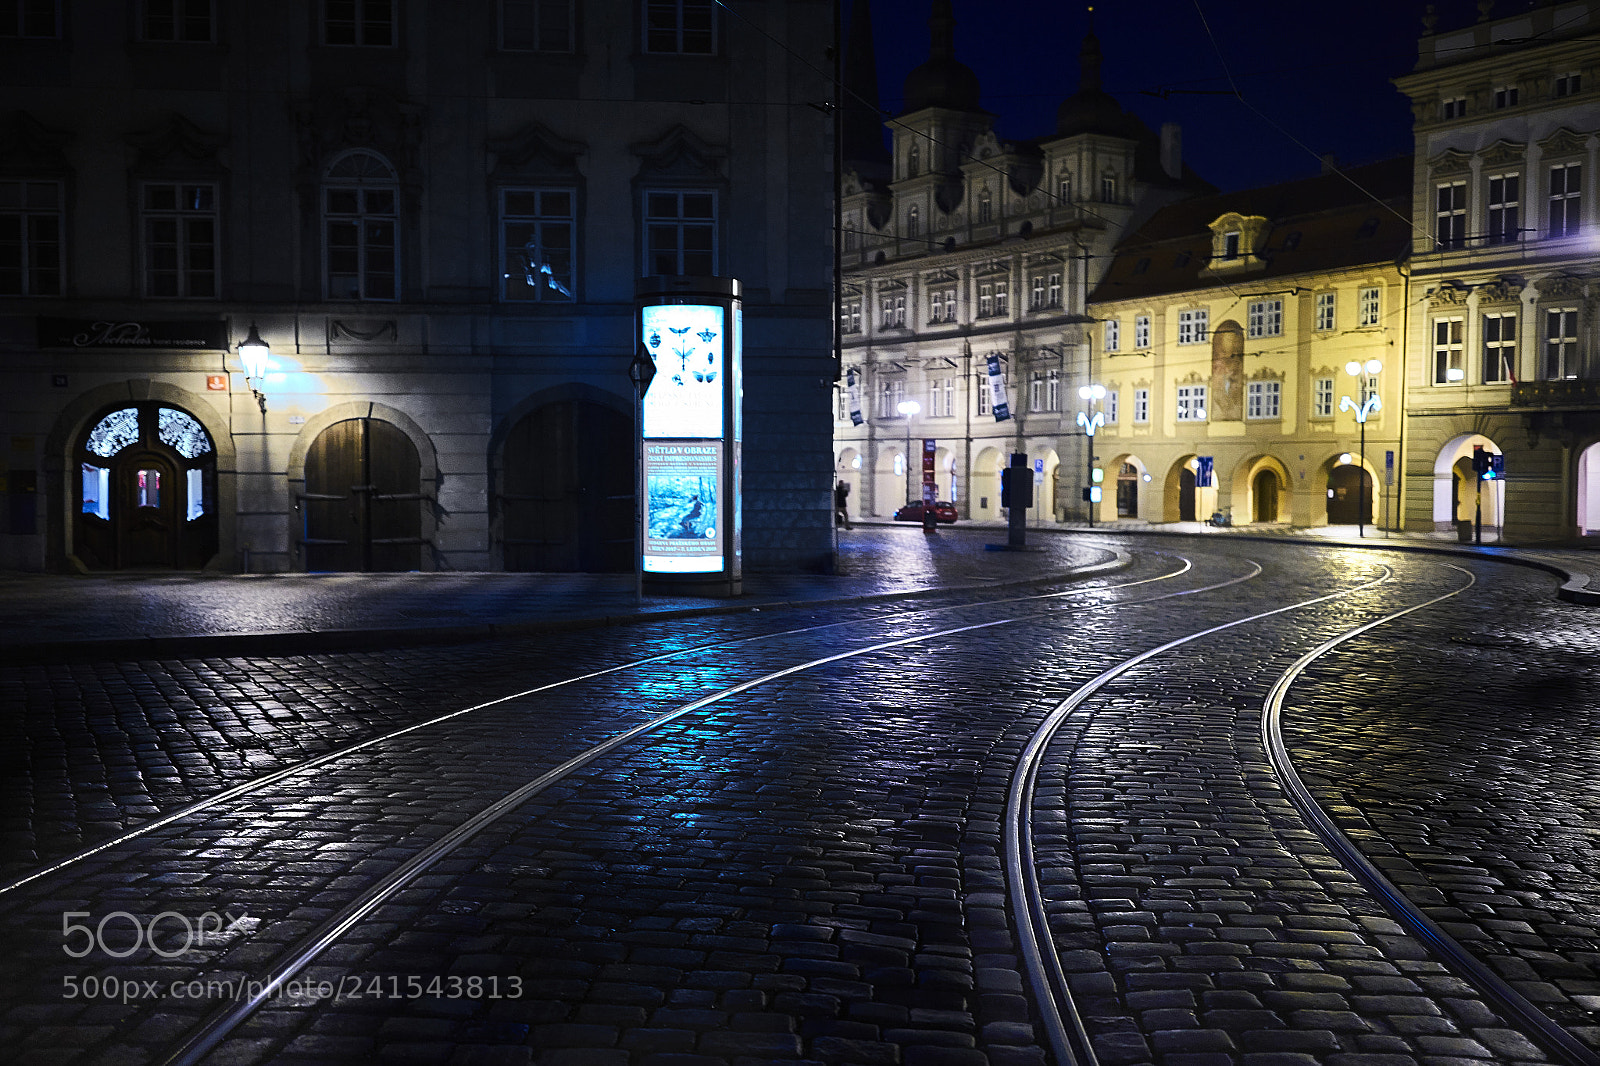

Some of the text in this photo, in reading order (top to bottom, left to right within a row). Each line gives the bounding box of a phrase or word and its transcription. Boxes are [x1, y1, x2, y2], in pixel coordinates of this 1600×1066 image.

[73, 322, 151, 347] Nicholas
[647, 445, 677, 455] SVĚTLO
[684, 446, 717, 455] OBRAZE
